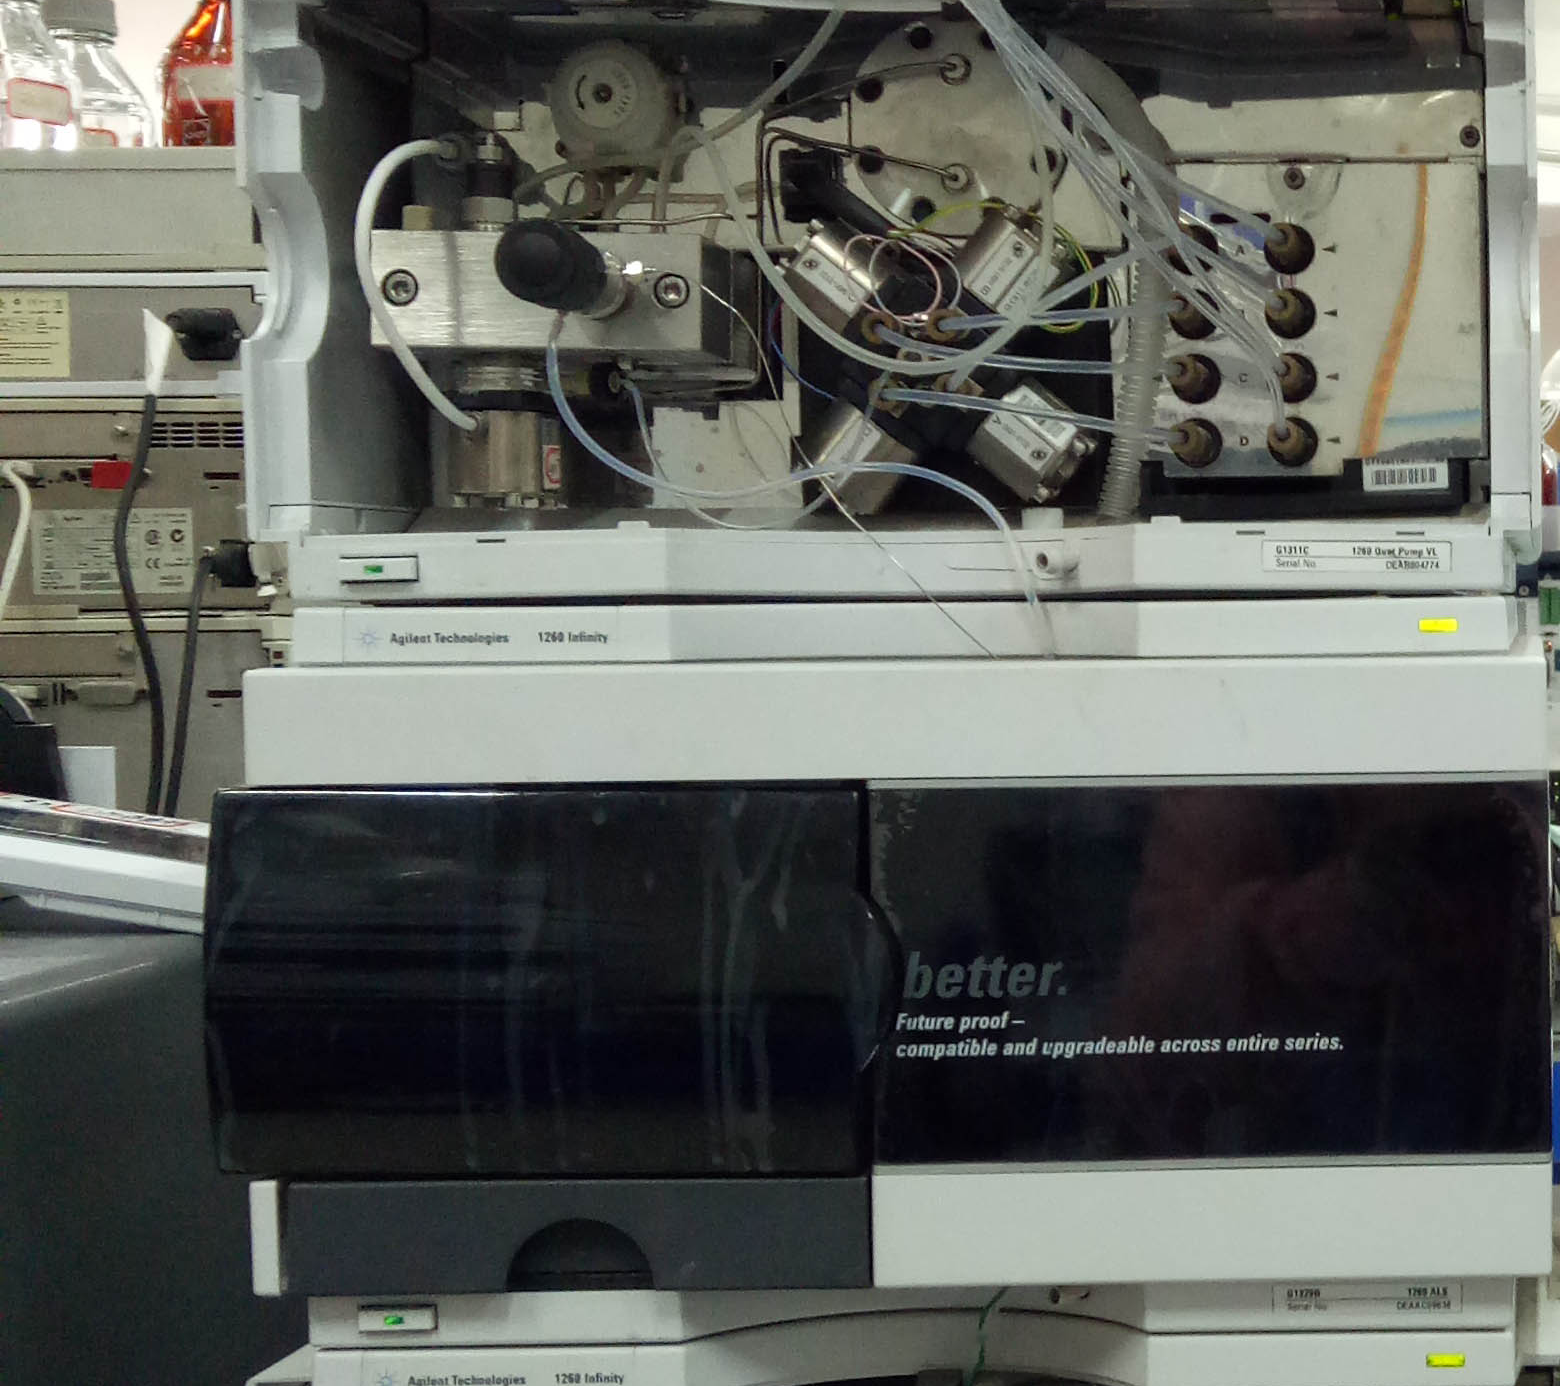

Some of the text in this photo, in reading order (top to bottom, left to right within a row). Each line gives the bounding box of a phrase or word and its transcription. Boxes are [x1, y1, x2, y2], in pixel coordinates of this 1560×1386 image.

[390, 631, 509, 646] Agilent Technologies
[568, 631, 608, 646] Infinity
[903, 951, 1068, 1000] better.
[897, 1013, 955, 1031] Future
[960, 1012, 1009, 1033] proof
[897, 1033, 1344, 1060] compatible and upgradeable across entire series.
[452, 1374, 526, 1386] Technologies
[584, 1372, 624, 1385] Infinity
